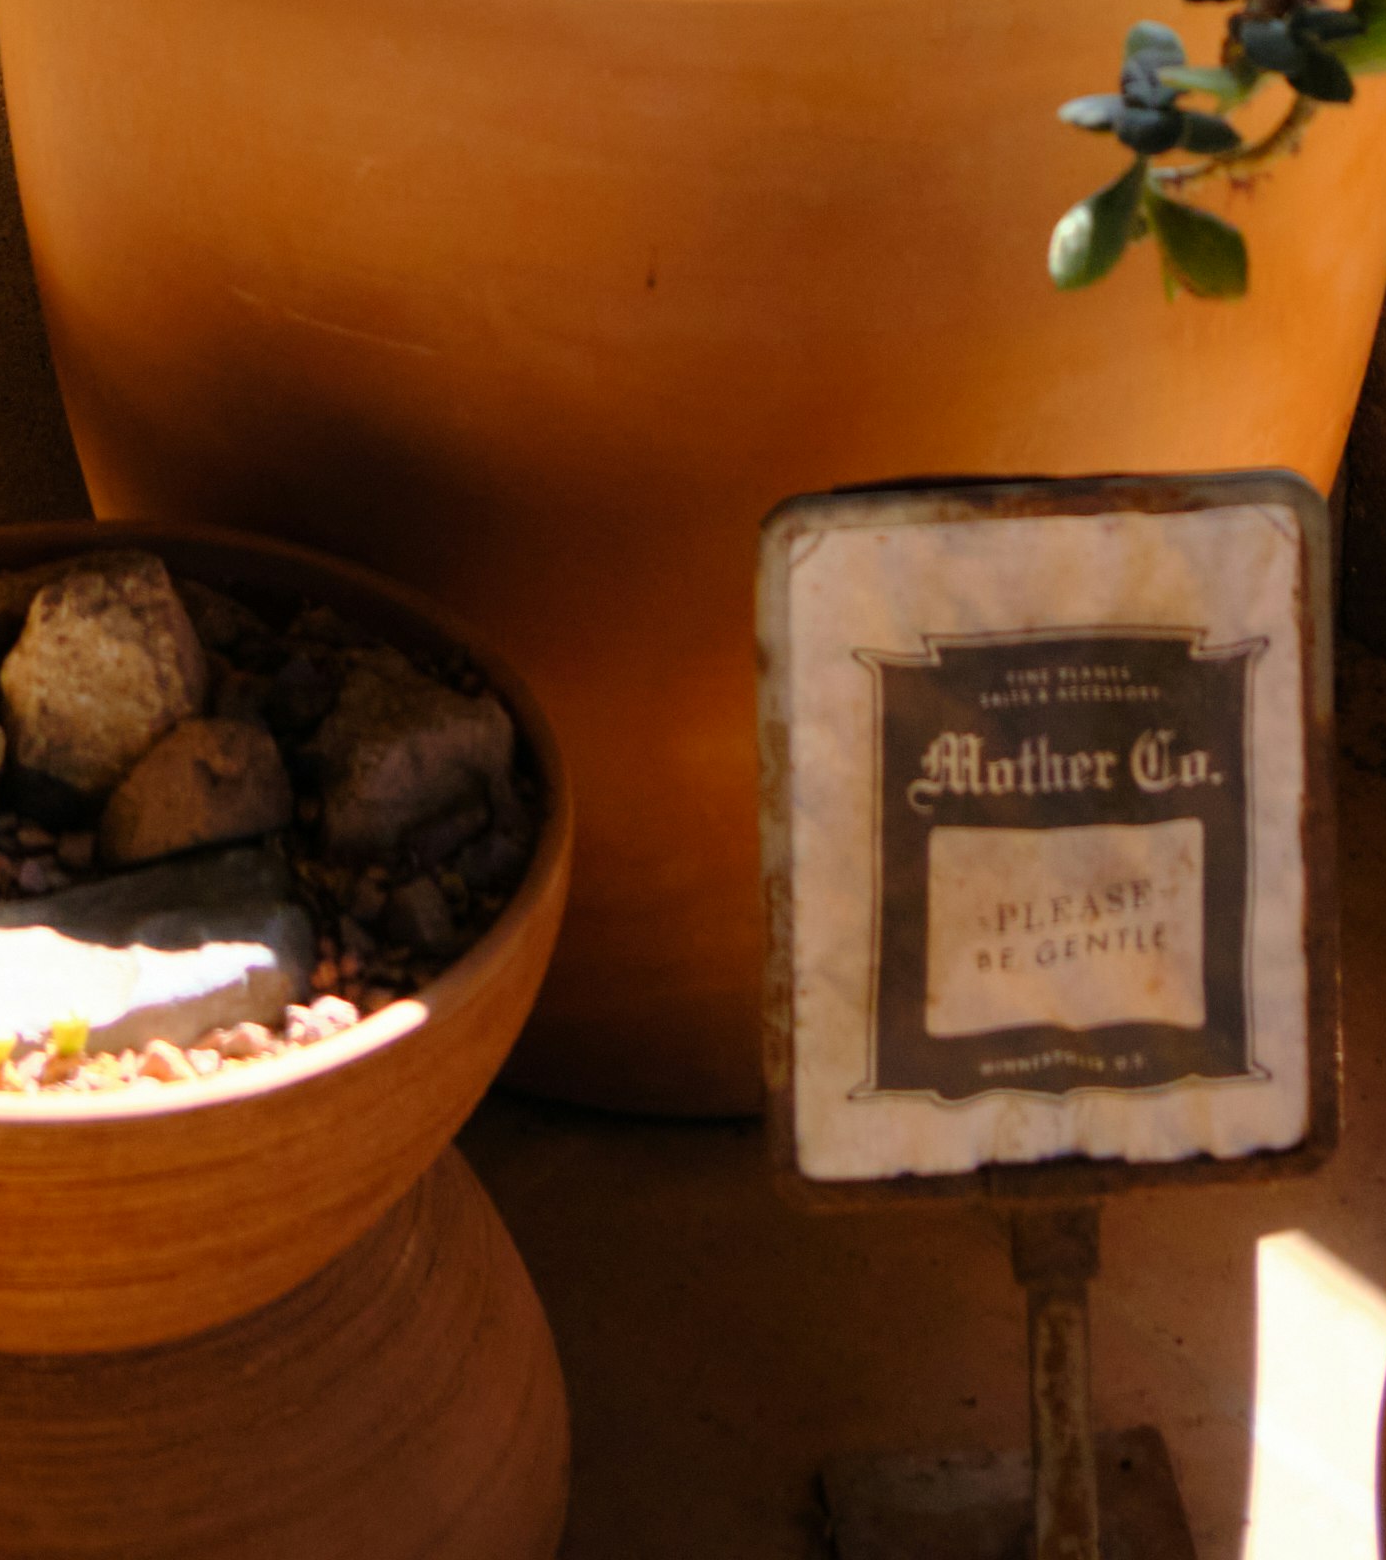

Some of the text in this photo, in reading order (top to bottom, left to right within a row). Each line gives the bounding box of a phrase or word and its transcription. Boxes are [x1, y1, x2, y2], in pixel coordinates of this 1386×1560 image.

[906, 728, 1225, 816] Mother Co.
[996, 877, 1153, 937] PLEASE
[975, 921, 1168, 975] BE GENTLE
